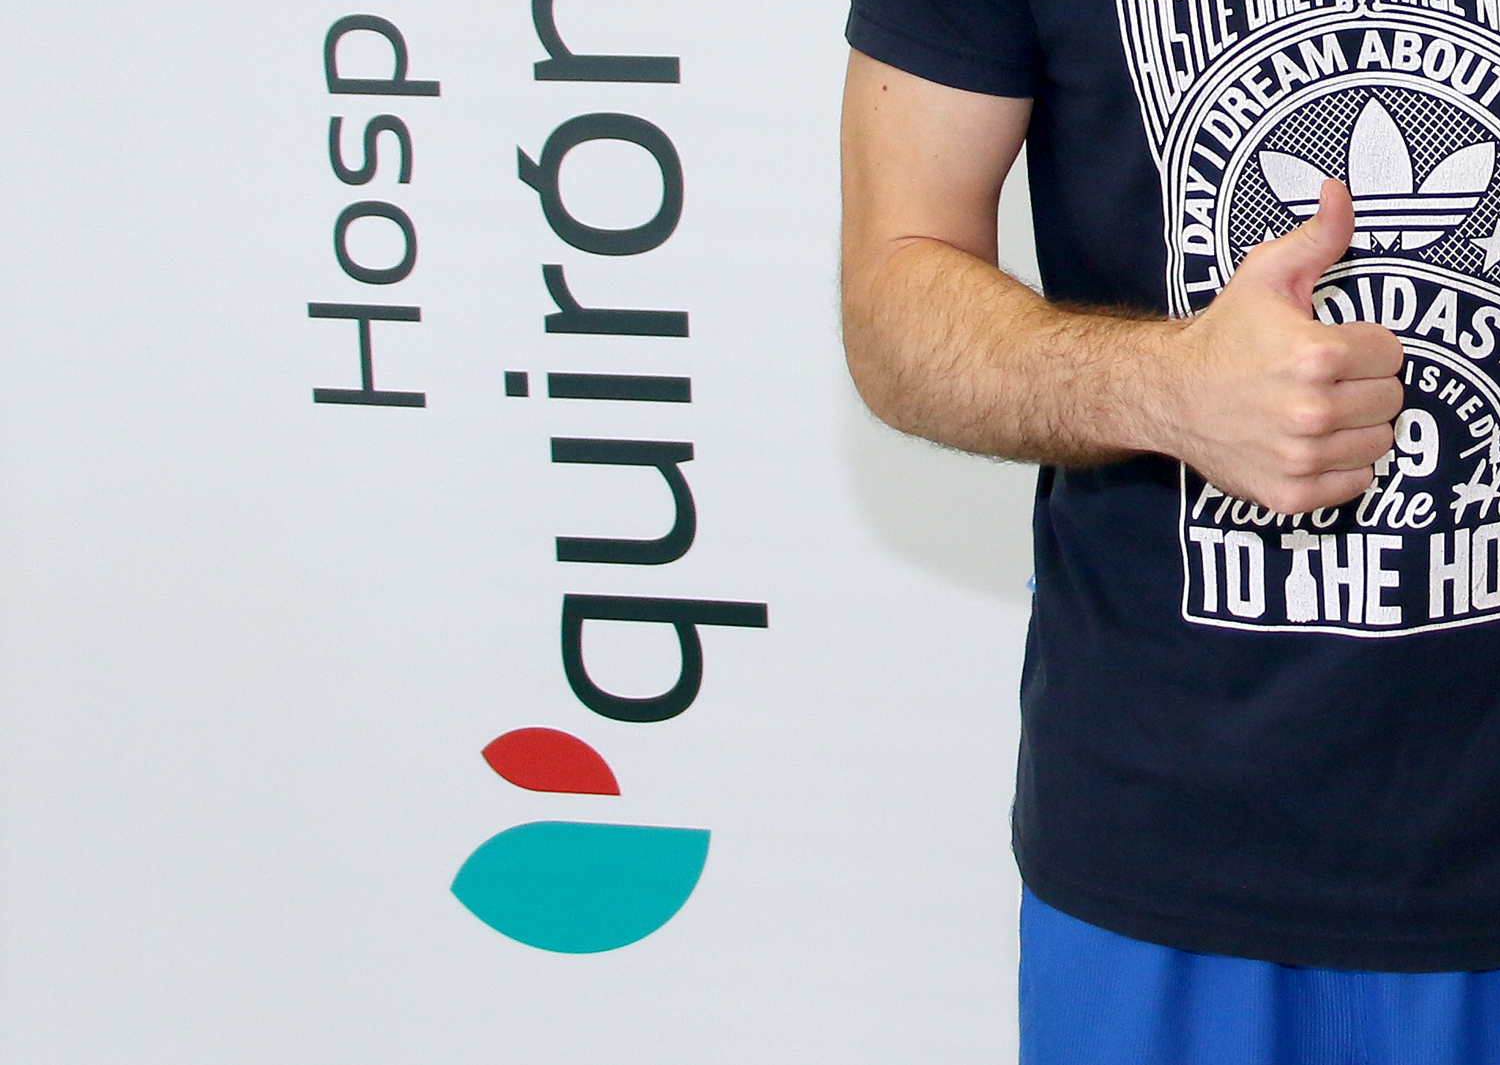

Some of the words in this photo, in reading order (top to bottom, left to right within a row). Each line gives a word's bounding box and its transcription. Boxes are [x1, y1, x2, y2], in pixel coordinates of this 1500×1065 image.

[1201, 33, 1349, 152] DREAM
[1193, 142, 1226, 171] I
[1182, 164, 1217, 256] DAY
[1404, 360, 1496, 438] ISHED
[1356, 470, 1437, 529] the
[1188, 526, 1266, 619] TO
[1281, 528, 1403, 626] THE
